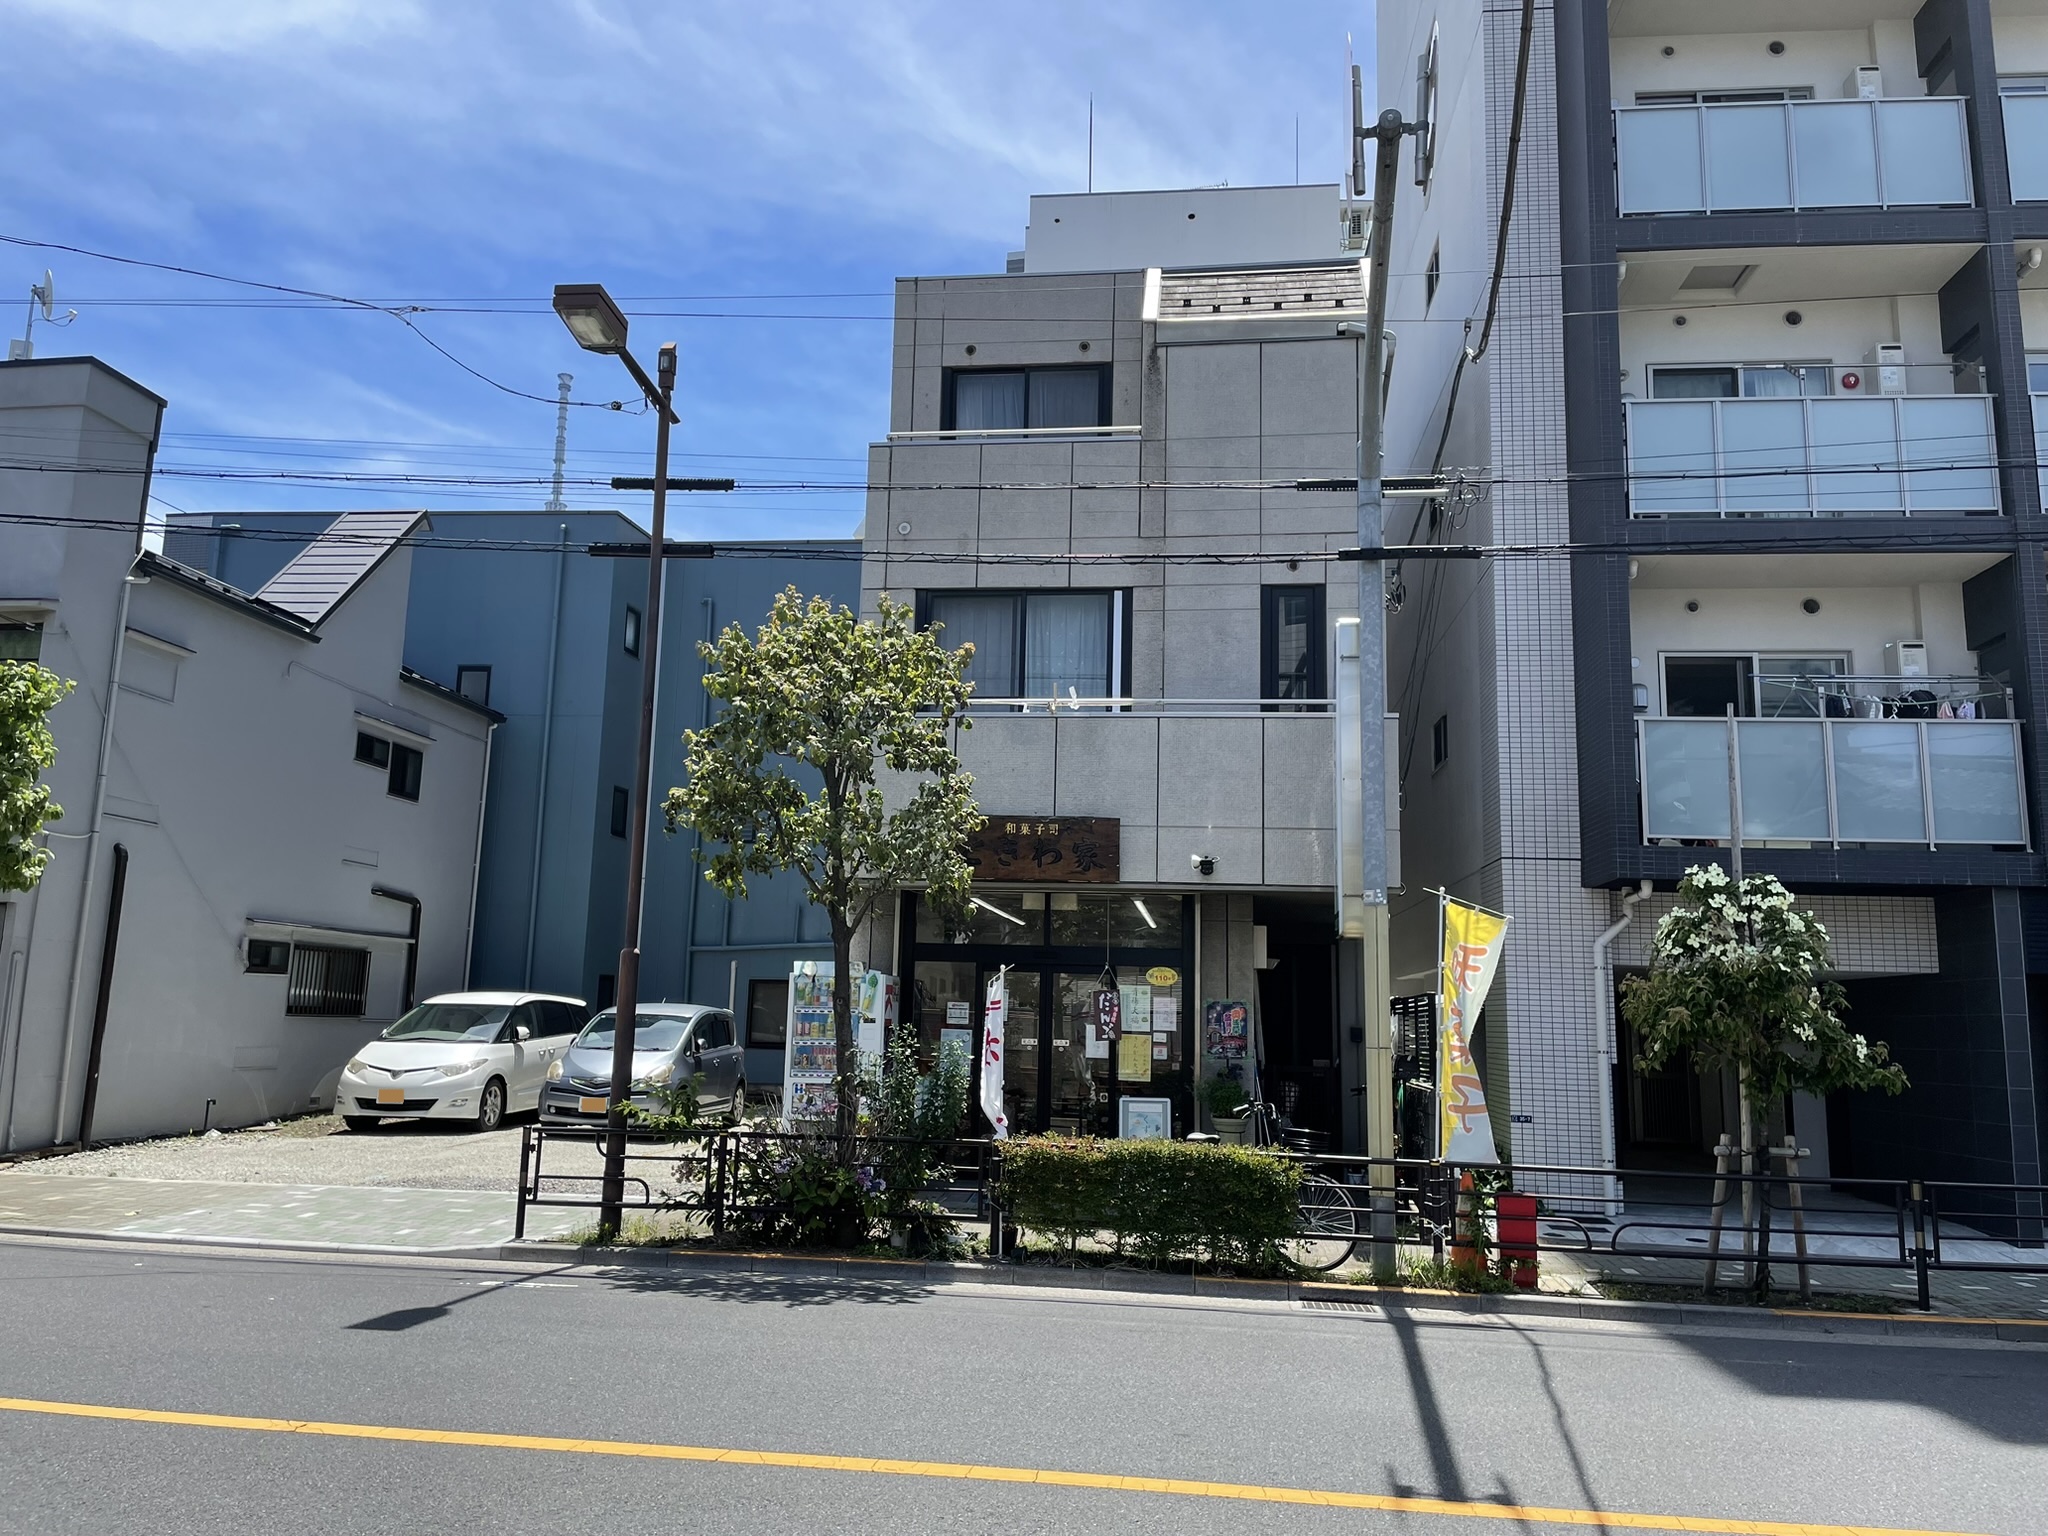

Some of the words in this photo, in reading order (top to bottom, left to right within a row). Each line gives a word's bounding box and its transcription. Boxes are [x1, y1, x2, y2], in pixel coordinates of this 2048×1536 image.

[1004, 821, 1060, 837] 和菓子司
[1098, 991, 1115, 1040] だんご
